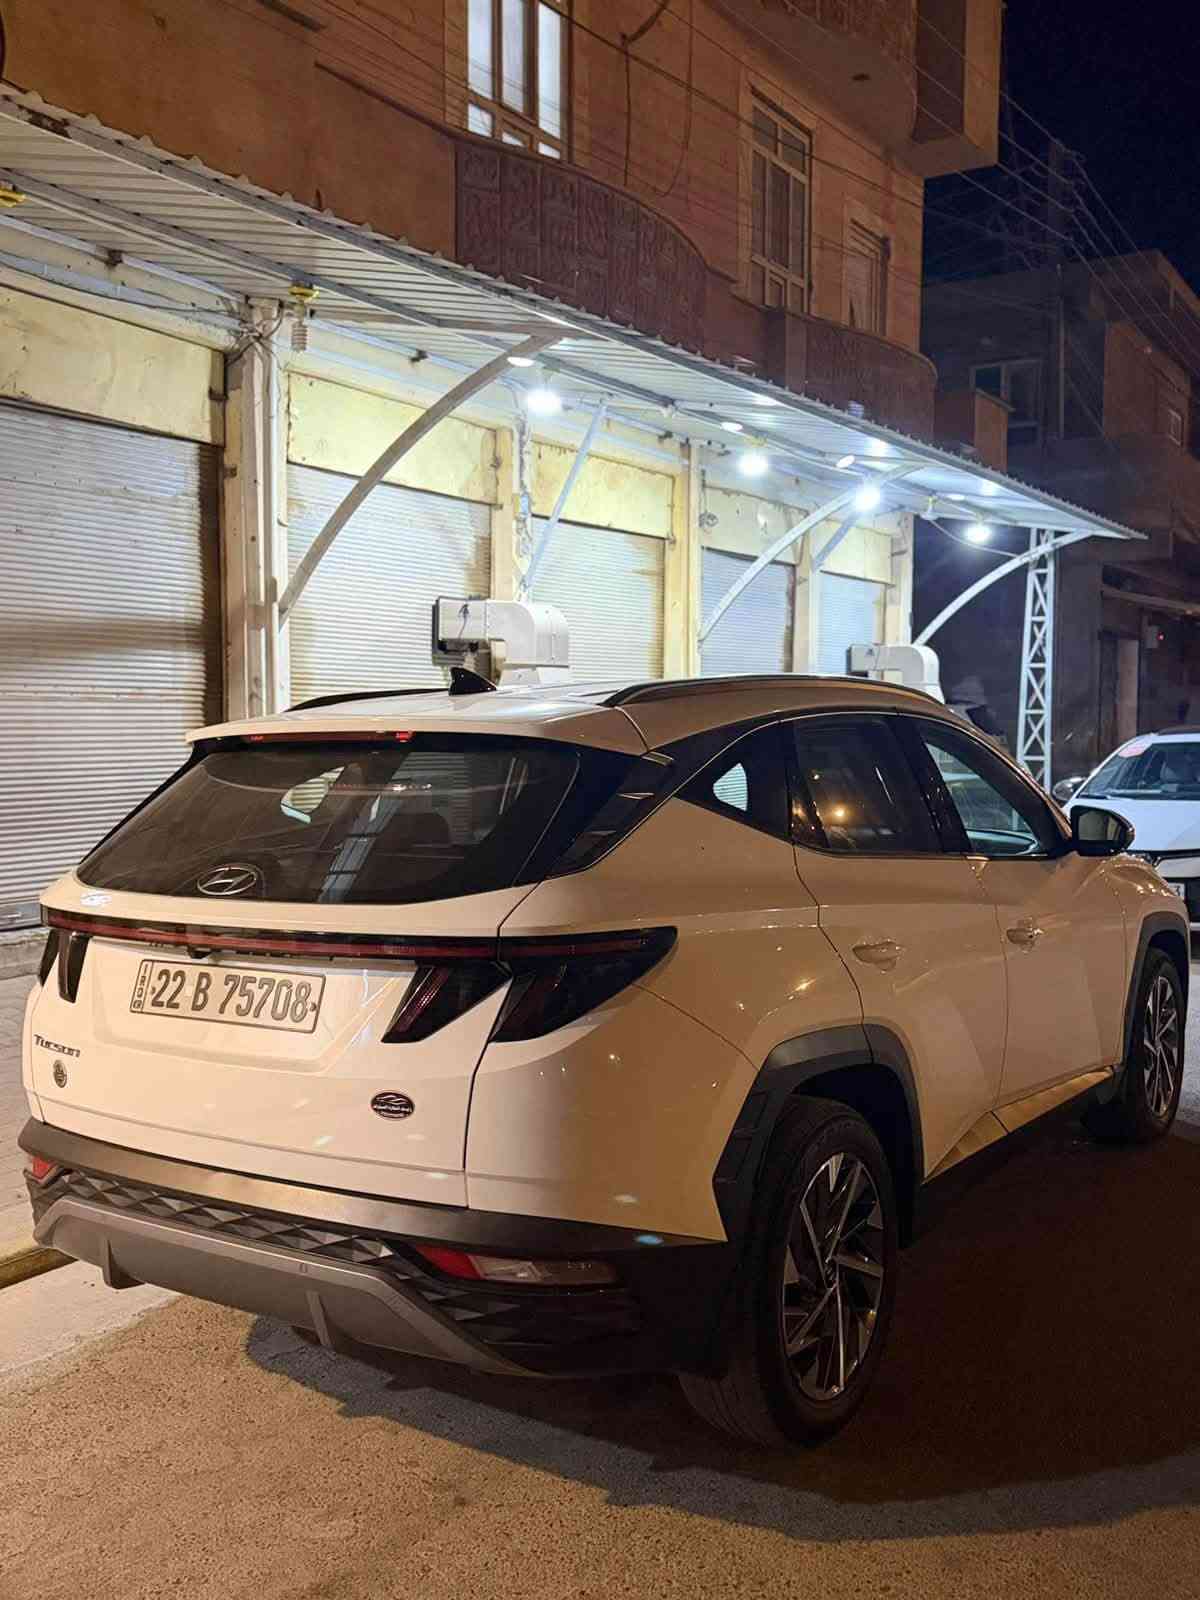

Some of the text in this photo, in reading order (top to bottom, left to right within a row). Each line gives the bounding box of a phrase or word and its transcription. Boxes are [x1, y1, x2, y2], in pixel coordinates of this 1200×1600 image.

[151, 969, 312, 1023] 22 B 75708
